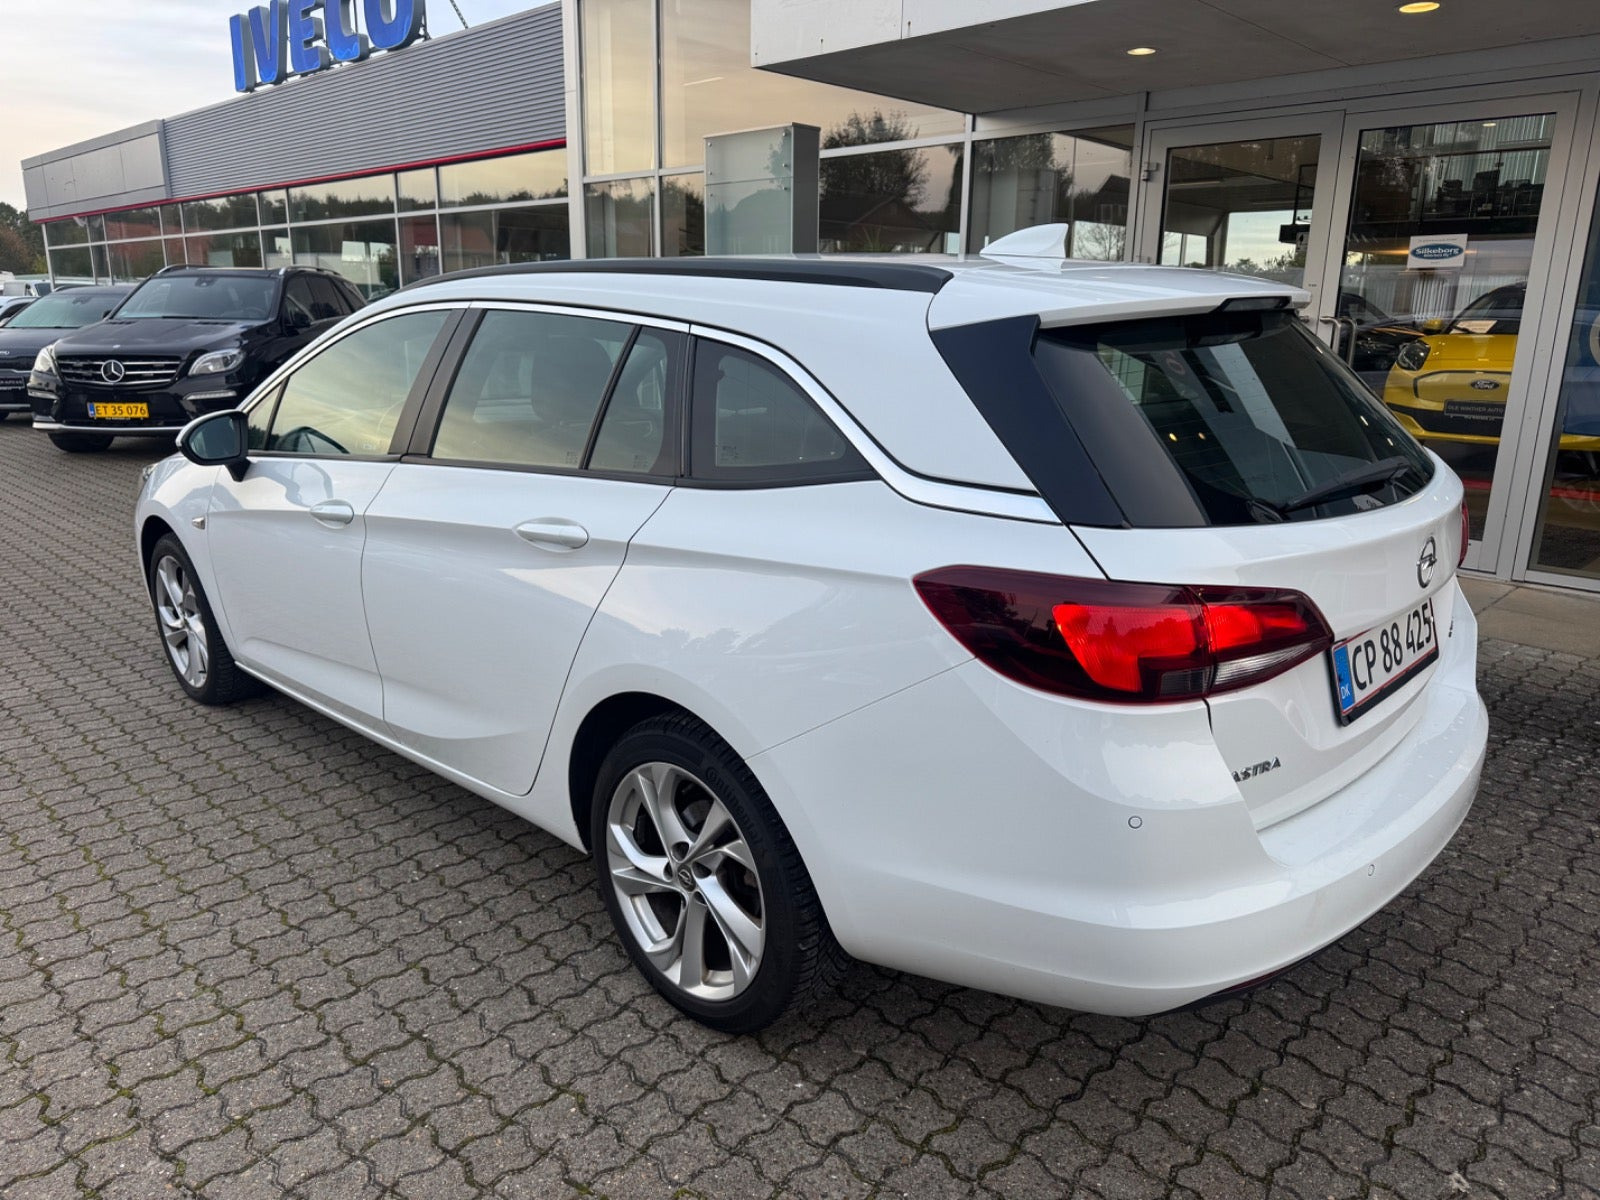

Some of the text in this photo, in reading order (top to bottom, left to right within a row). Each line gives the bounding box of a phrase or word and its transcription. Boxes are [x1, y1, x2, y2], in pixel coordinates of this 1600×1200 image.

[229, 0, 422, 92] IVECO
[1415, 247, 1460, 255] Silkeborg
[96, 405, 107, 416] ET
[111, 405, 123, 416] 35
[126, 405, 146, 416] 076
[1352, 639, 1377, 691] CP
[1380, 622, 1403, 673] 88
[1405, 602, 1432, 654] 425
[1340, 683, 1351, 700] DK
[1231, 756, 1281, 783] ASTRA
